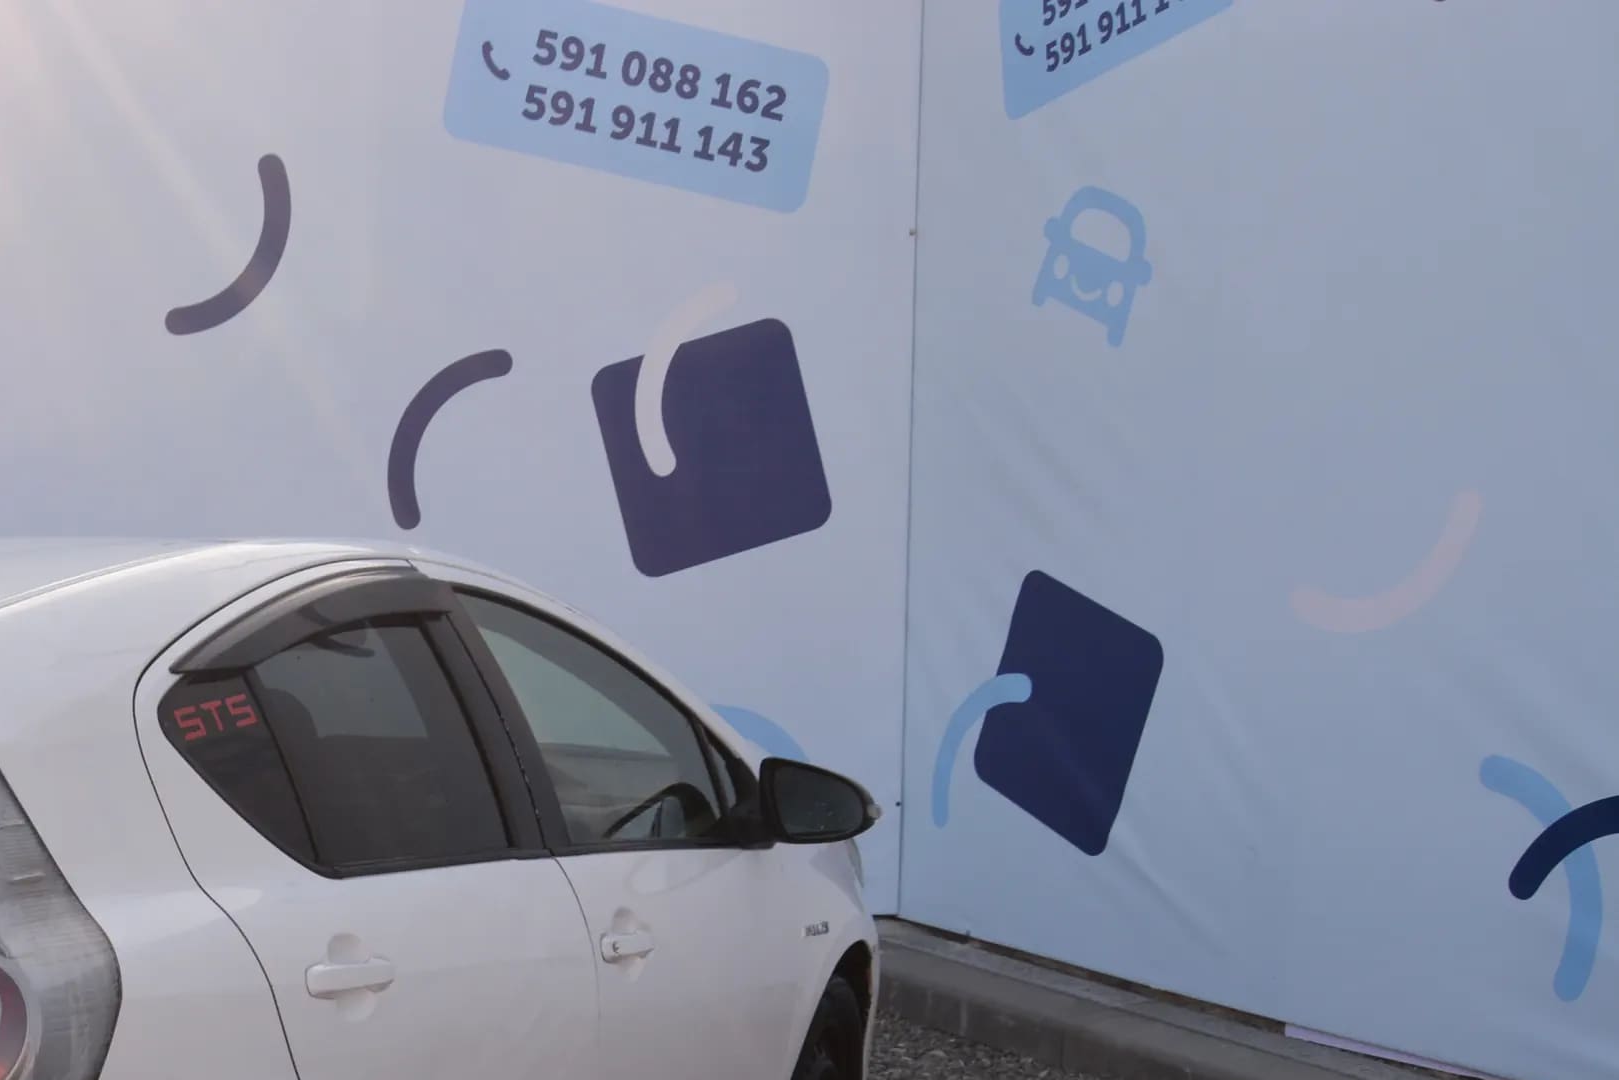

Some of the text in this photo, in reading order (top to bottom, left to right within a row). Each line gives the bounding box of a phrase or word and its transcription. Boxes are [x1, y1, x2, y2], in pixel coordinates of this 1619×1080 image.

[1042, 0, 1090, 27] 59
[1044, 0, 1148, 73] 591 911
[531, 28, 788, 122] 591 088 162
[520, 83, 772, 173] 591 911 143
[173, 694, 258, 740] STS
